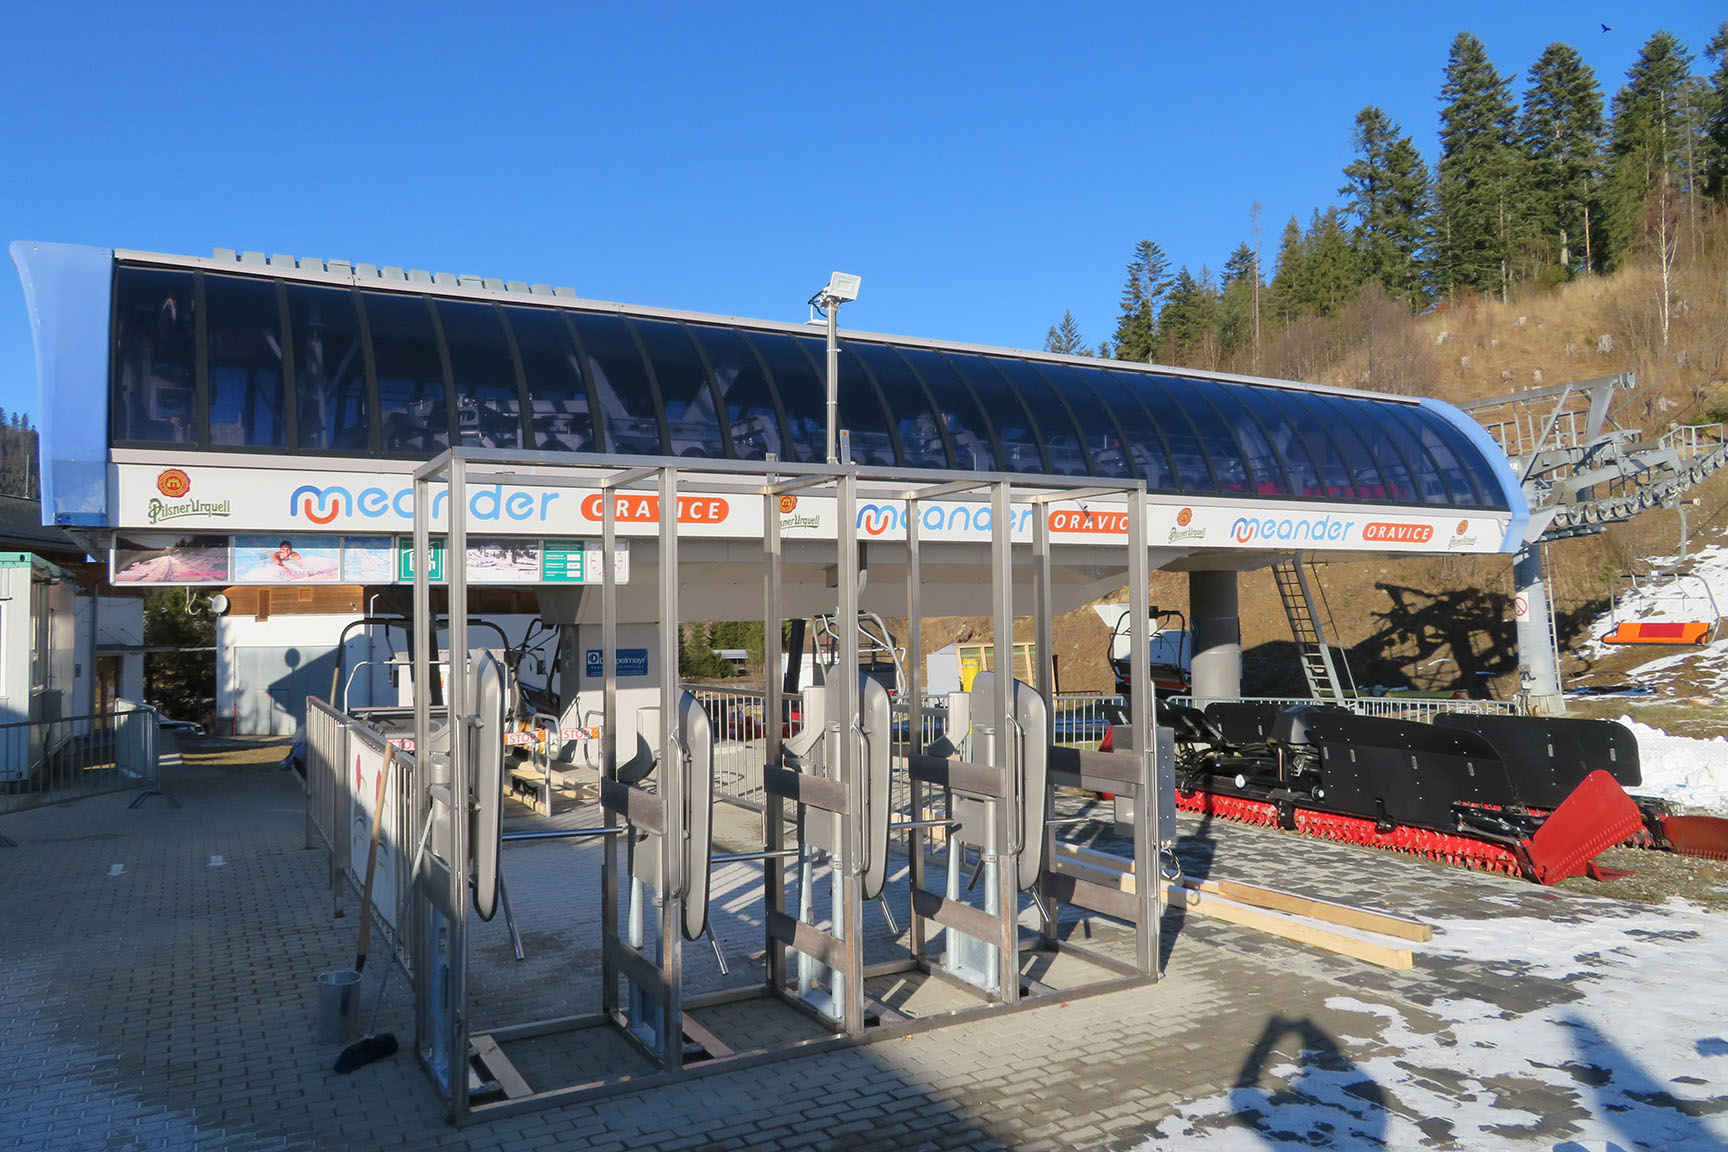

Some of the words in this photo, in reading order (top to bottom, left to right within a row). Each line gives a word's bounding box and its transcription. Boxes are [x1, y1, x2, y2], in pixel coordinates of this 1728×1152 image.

[148, 497, 191, 524] Pilsner
[190, 499, 230, 517] Urquell
[591, 499, 721, 519] ORAICE
[1230, 514, 1355, 543] meander
[1367, 525, 1430, 540] ORAVICE
